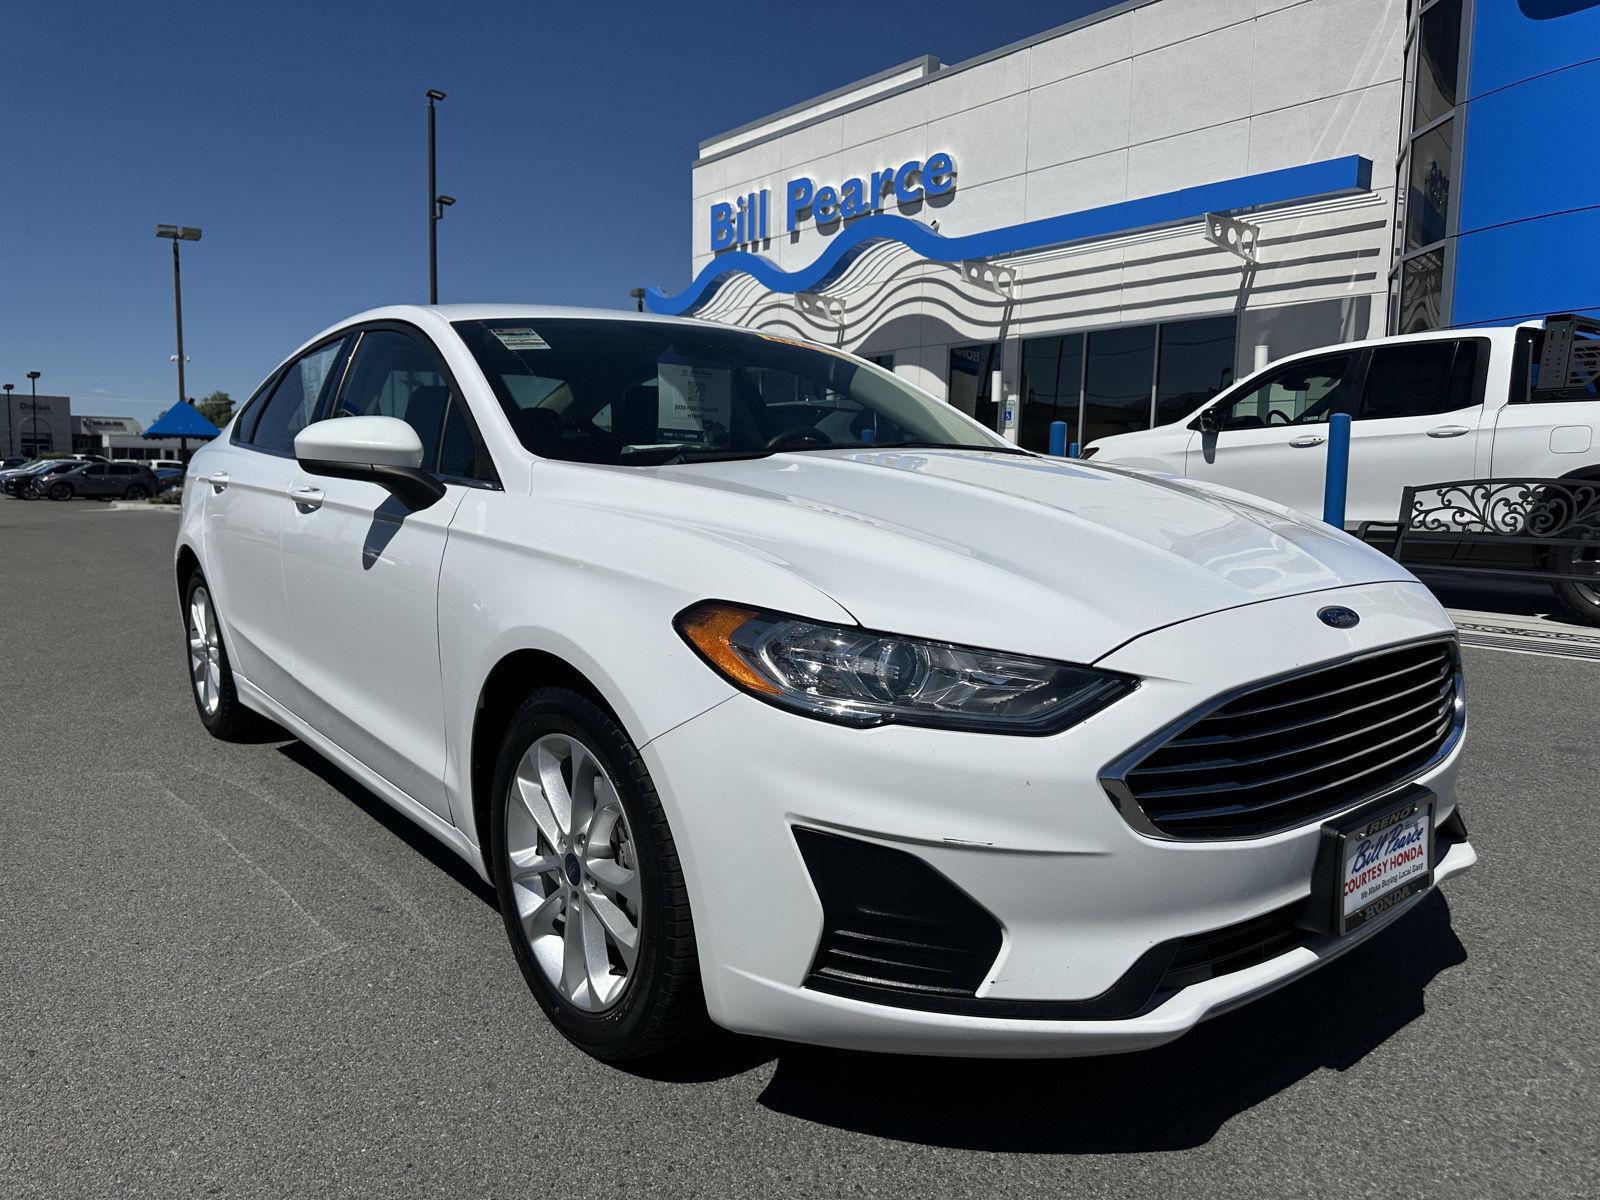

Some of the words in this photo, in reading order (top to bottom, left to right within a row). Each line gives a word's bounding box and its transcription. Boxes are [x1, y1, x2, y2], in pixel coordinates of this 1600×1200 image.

[710, 189, 769, 251] Bill
[787, 152, 958, 232] Pearce
[1368, 806, 1413, 834] RENO
[1344, 859, 1389, 897] COURTESY
[1389, 844, 1424, 870] HONDA
[1352, 833, 1388, 874] Bill
[1384, 823, 1424, 857] Pearce
[1360, 890, 1368, 900] We
[1368, 884, 1381, 896] Make
[1381, 874, 1398, 889] Buying
[1398, 866, 1412, 880] Local
[1412, 862, 1424, 875] Easy
